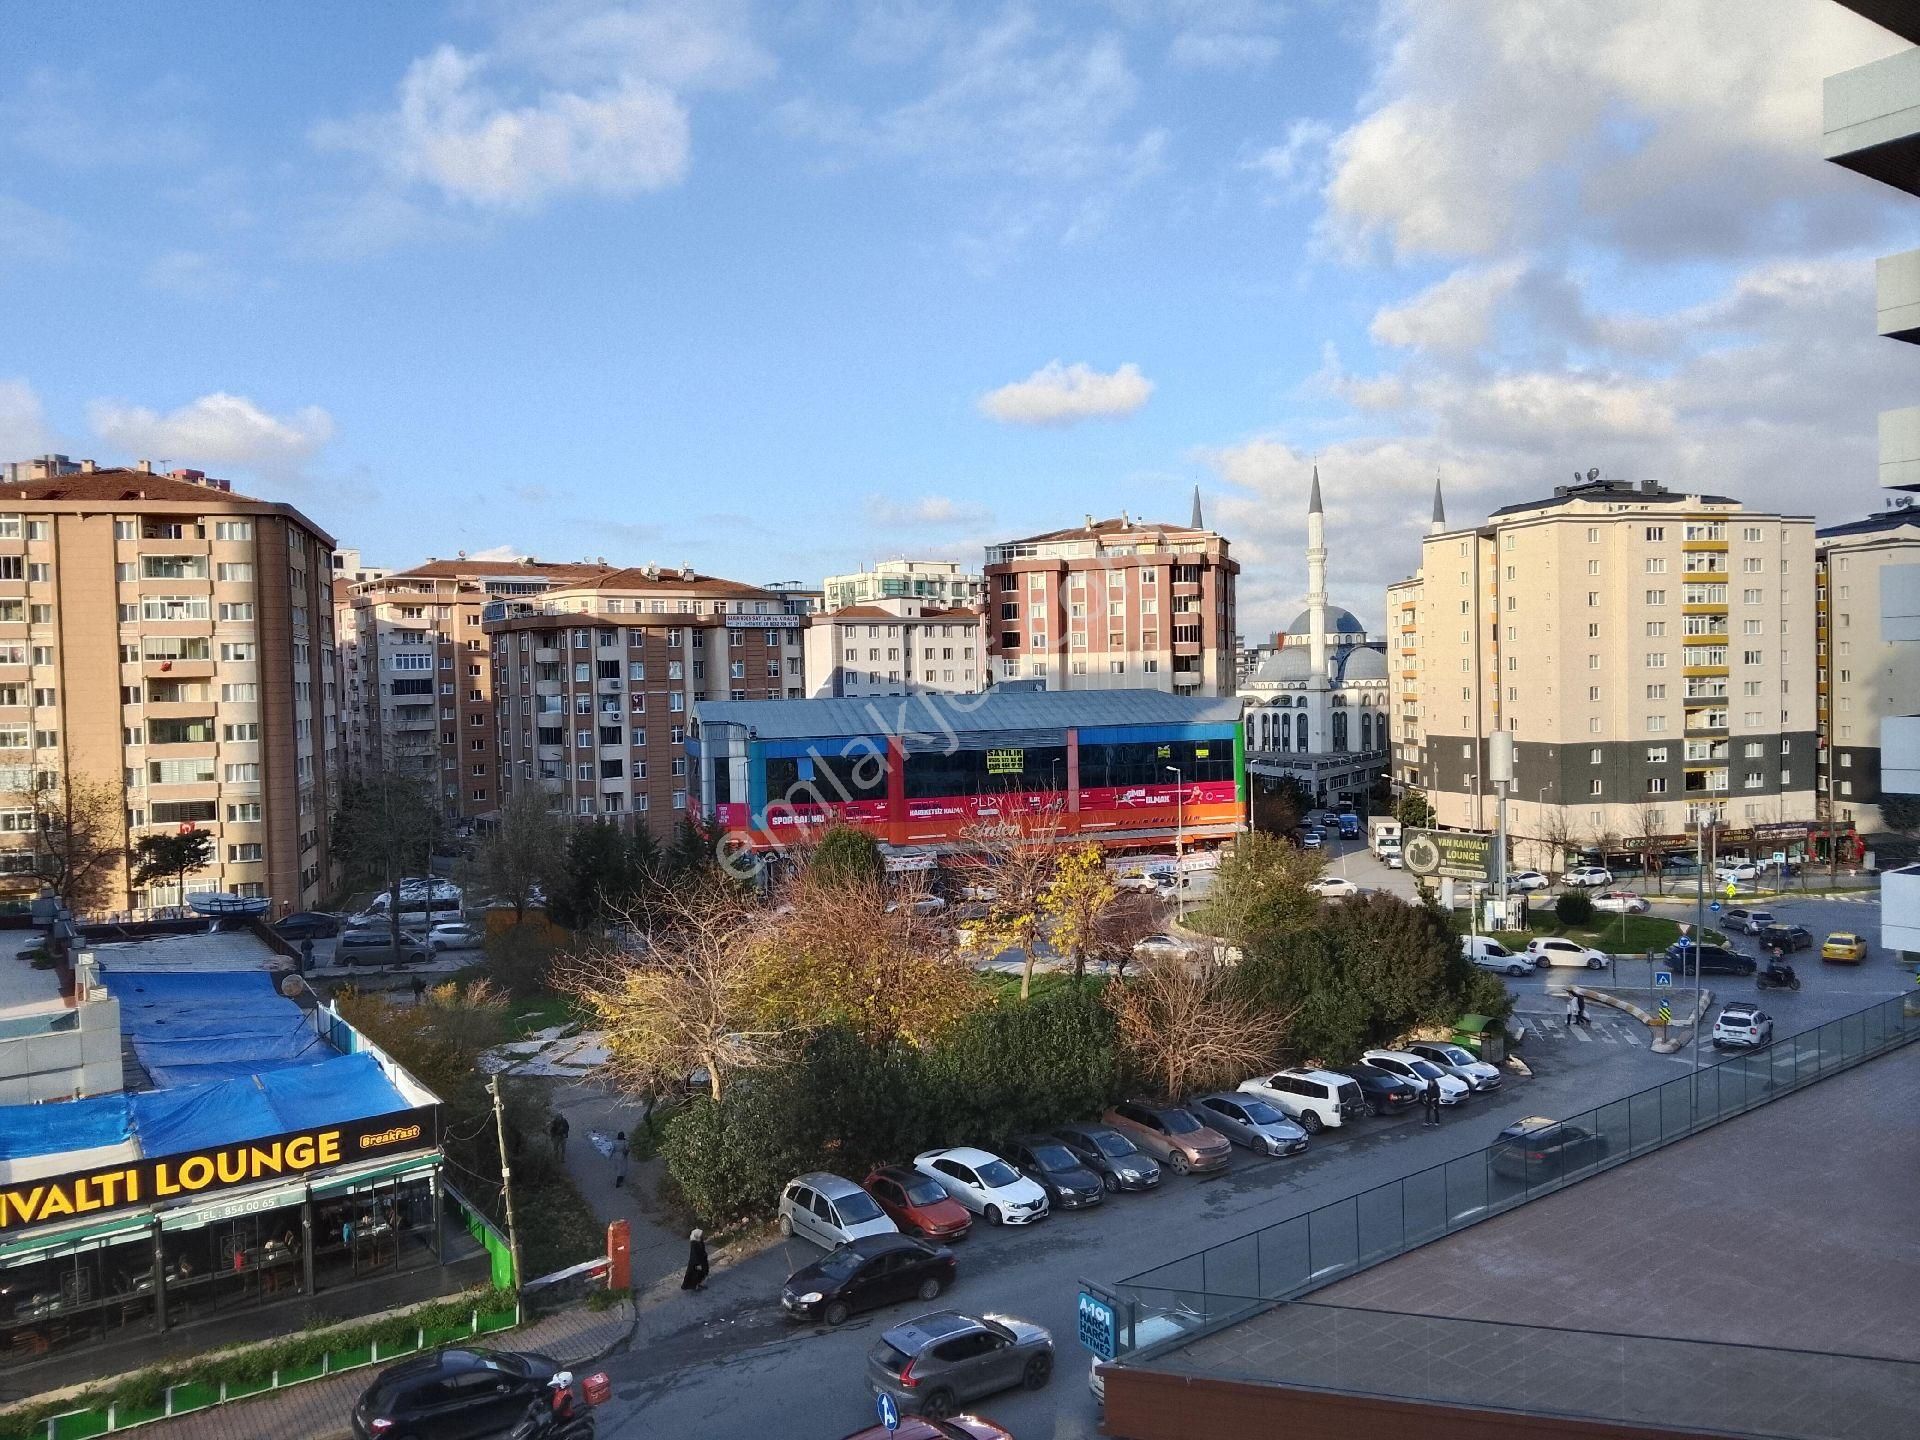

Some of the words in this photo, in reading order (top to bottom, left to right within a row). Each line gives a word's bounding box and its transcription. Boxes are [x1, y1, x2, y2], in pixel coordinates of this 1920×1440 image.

[987, 749, 1022, 757] SATILIK
[771, 816, 793, 825] SPOR
[1437, 838, 1452, 847] VAN
[1453, 839, 1489, 851] KAHVALTI
[1446, 850, 1480, 861] LOUNGE
[361, 1126, 419, 1147] Breakfast
[155, 1130, 340, 1196] LOUNGE
[196, 1210, 216, 1221] TEL
[224, 1204, 244, 1215] 854
[246, 1201, 259, 1211] 00
[262, 1199, 275, 1208] 65
[1080, 1308, 1110, 1337] HARCA
[1080, 1320, 1110, 1347] HARCA
